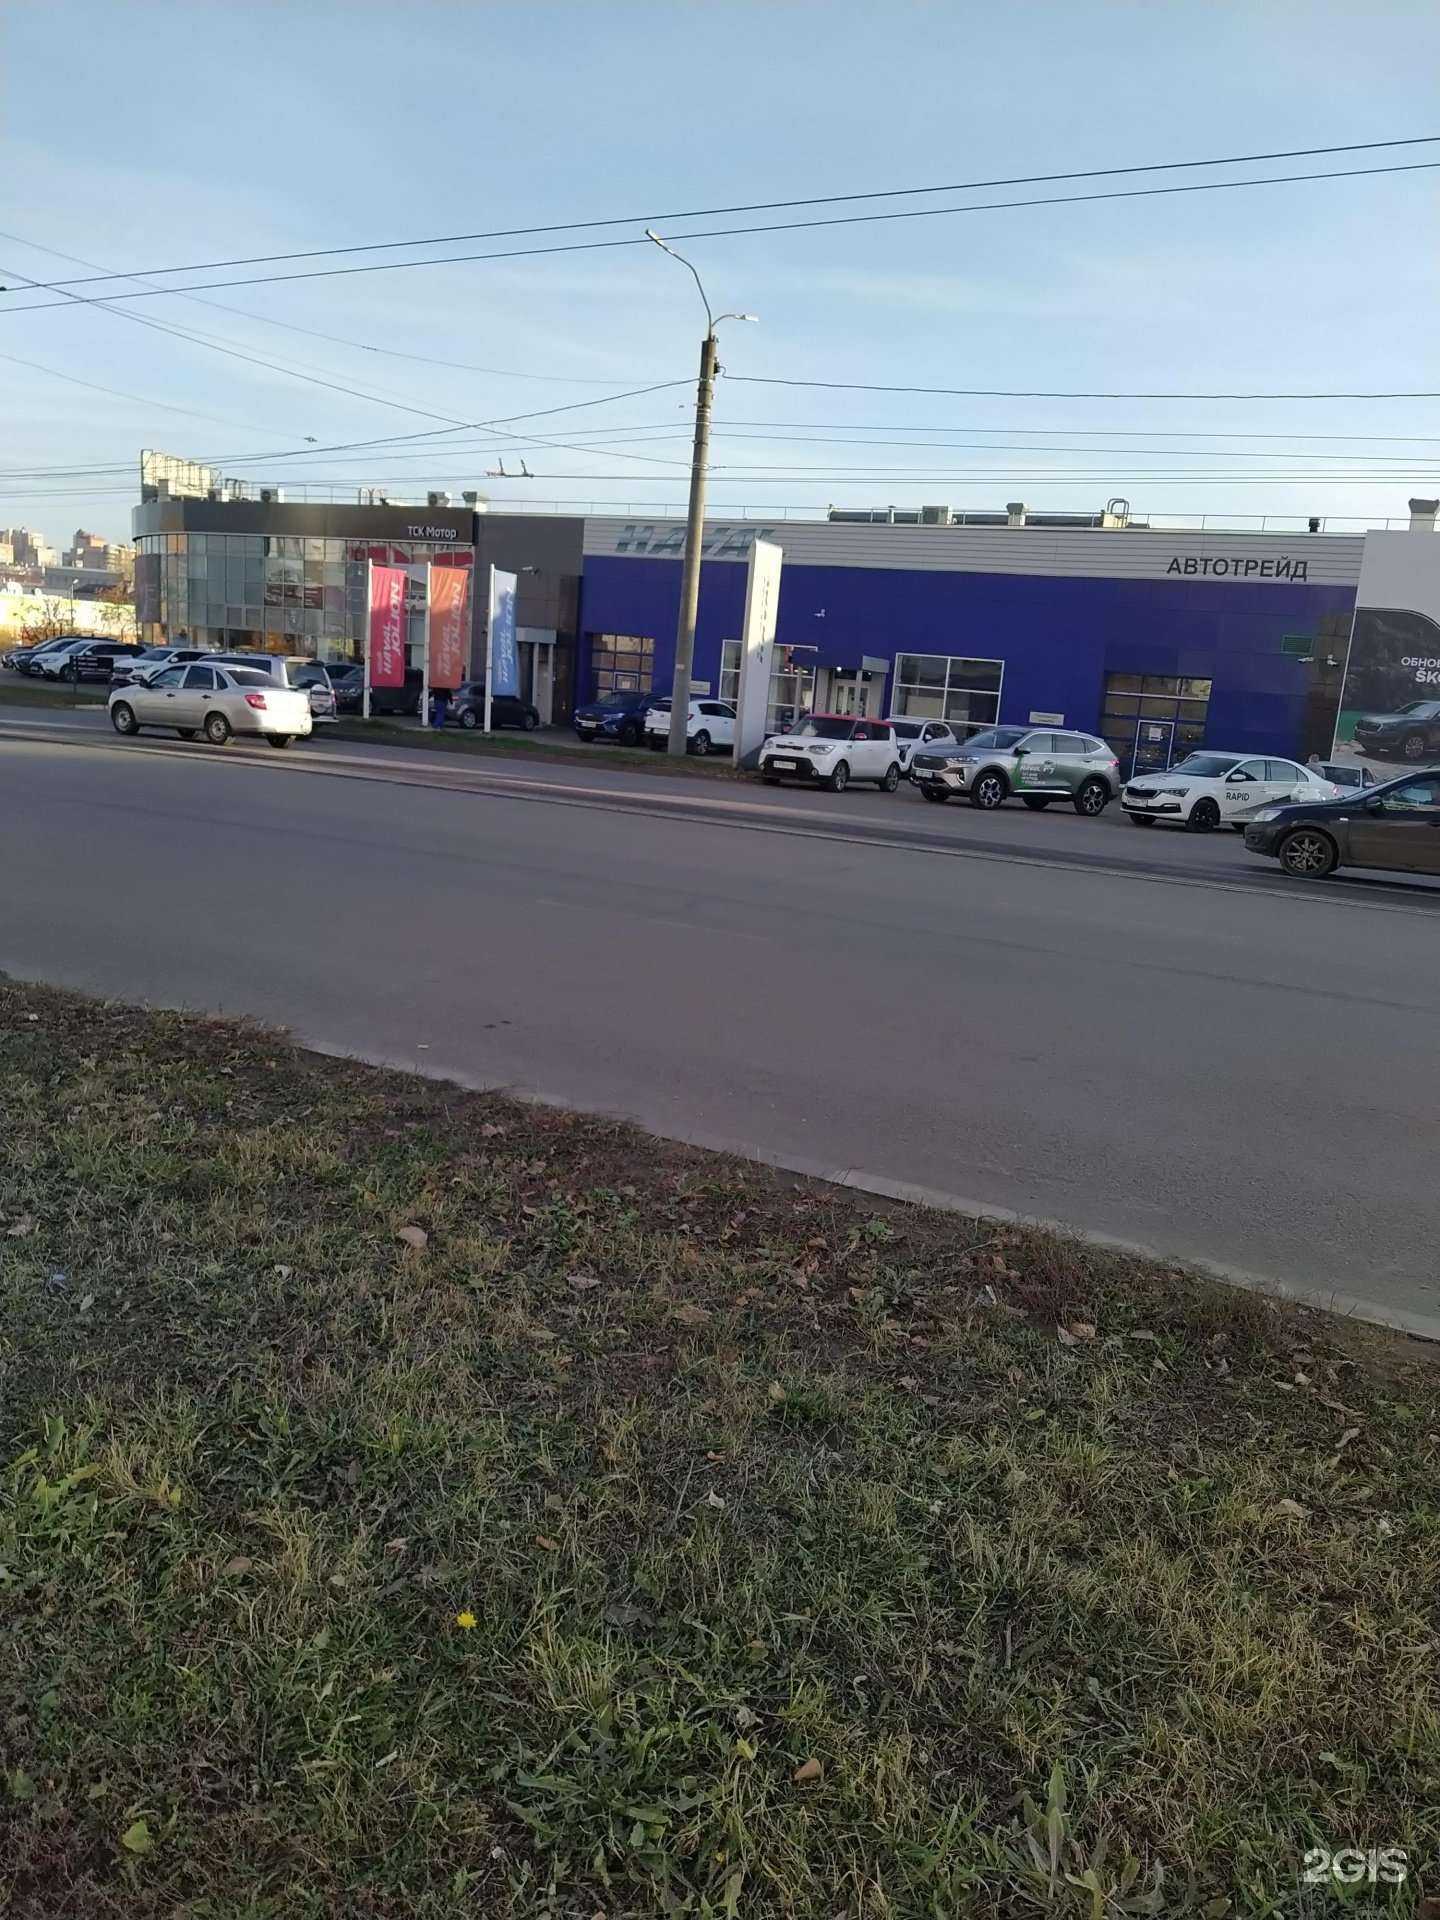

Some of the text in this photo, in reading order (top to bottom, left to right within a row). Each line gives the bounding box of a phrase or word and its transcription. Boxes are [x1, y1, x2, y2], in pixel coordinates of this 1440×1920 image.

[408, 526, 457, 539] ТСК Мотор
[616, 525, 776, 558] HAA
[1167, 556, 1308, 581] АВТОТРЕЙД
[1415, 667, 1440, 684] ŠK
[1225, 792, 1250, 801] RAPID
